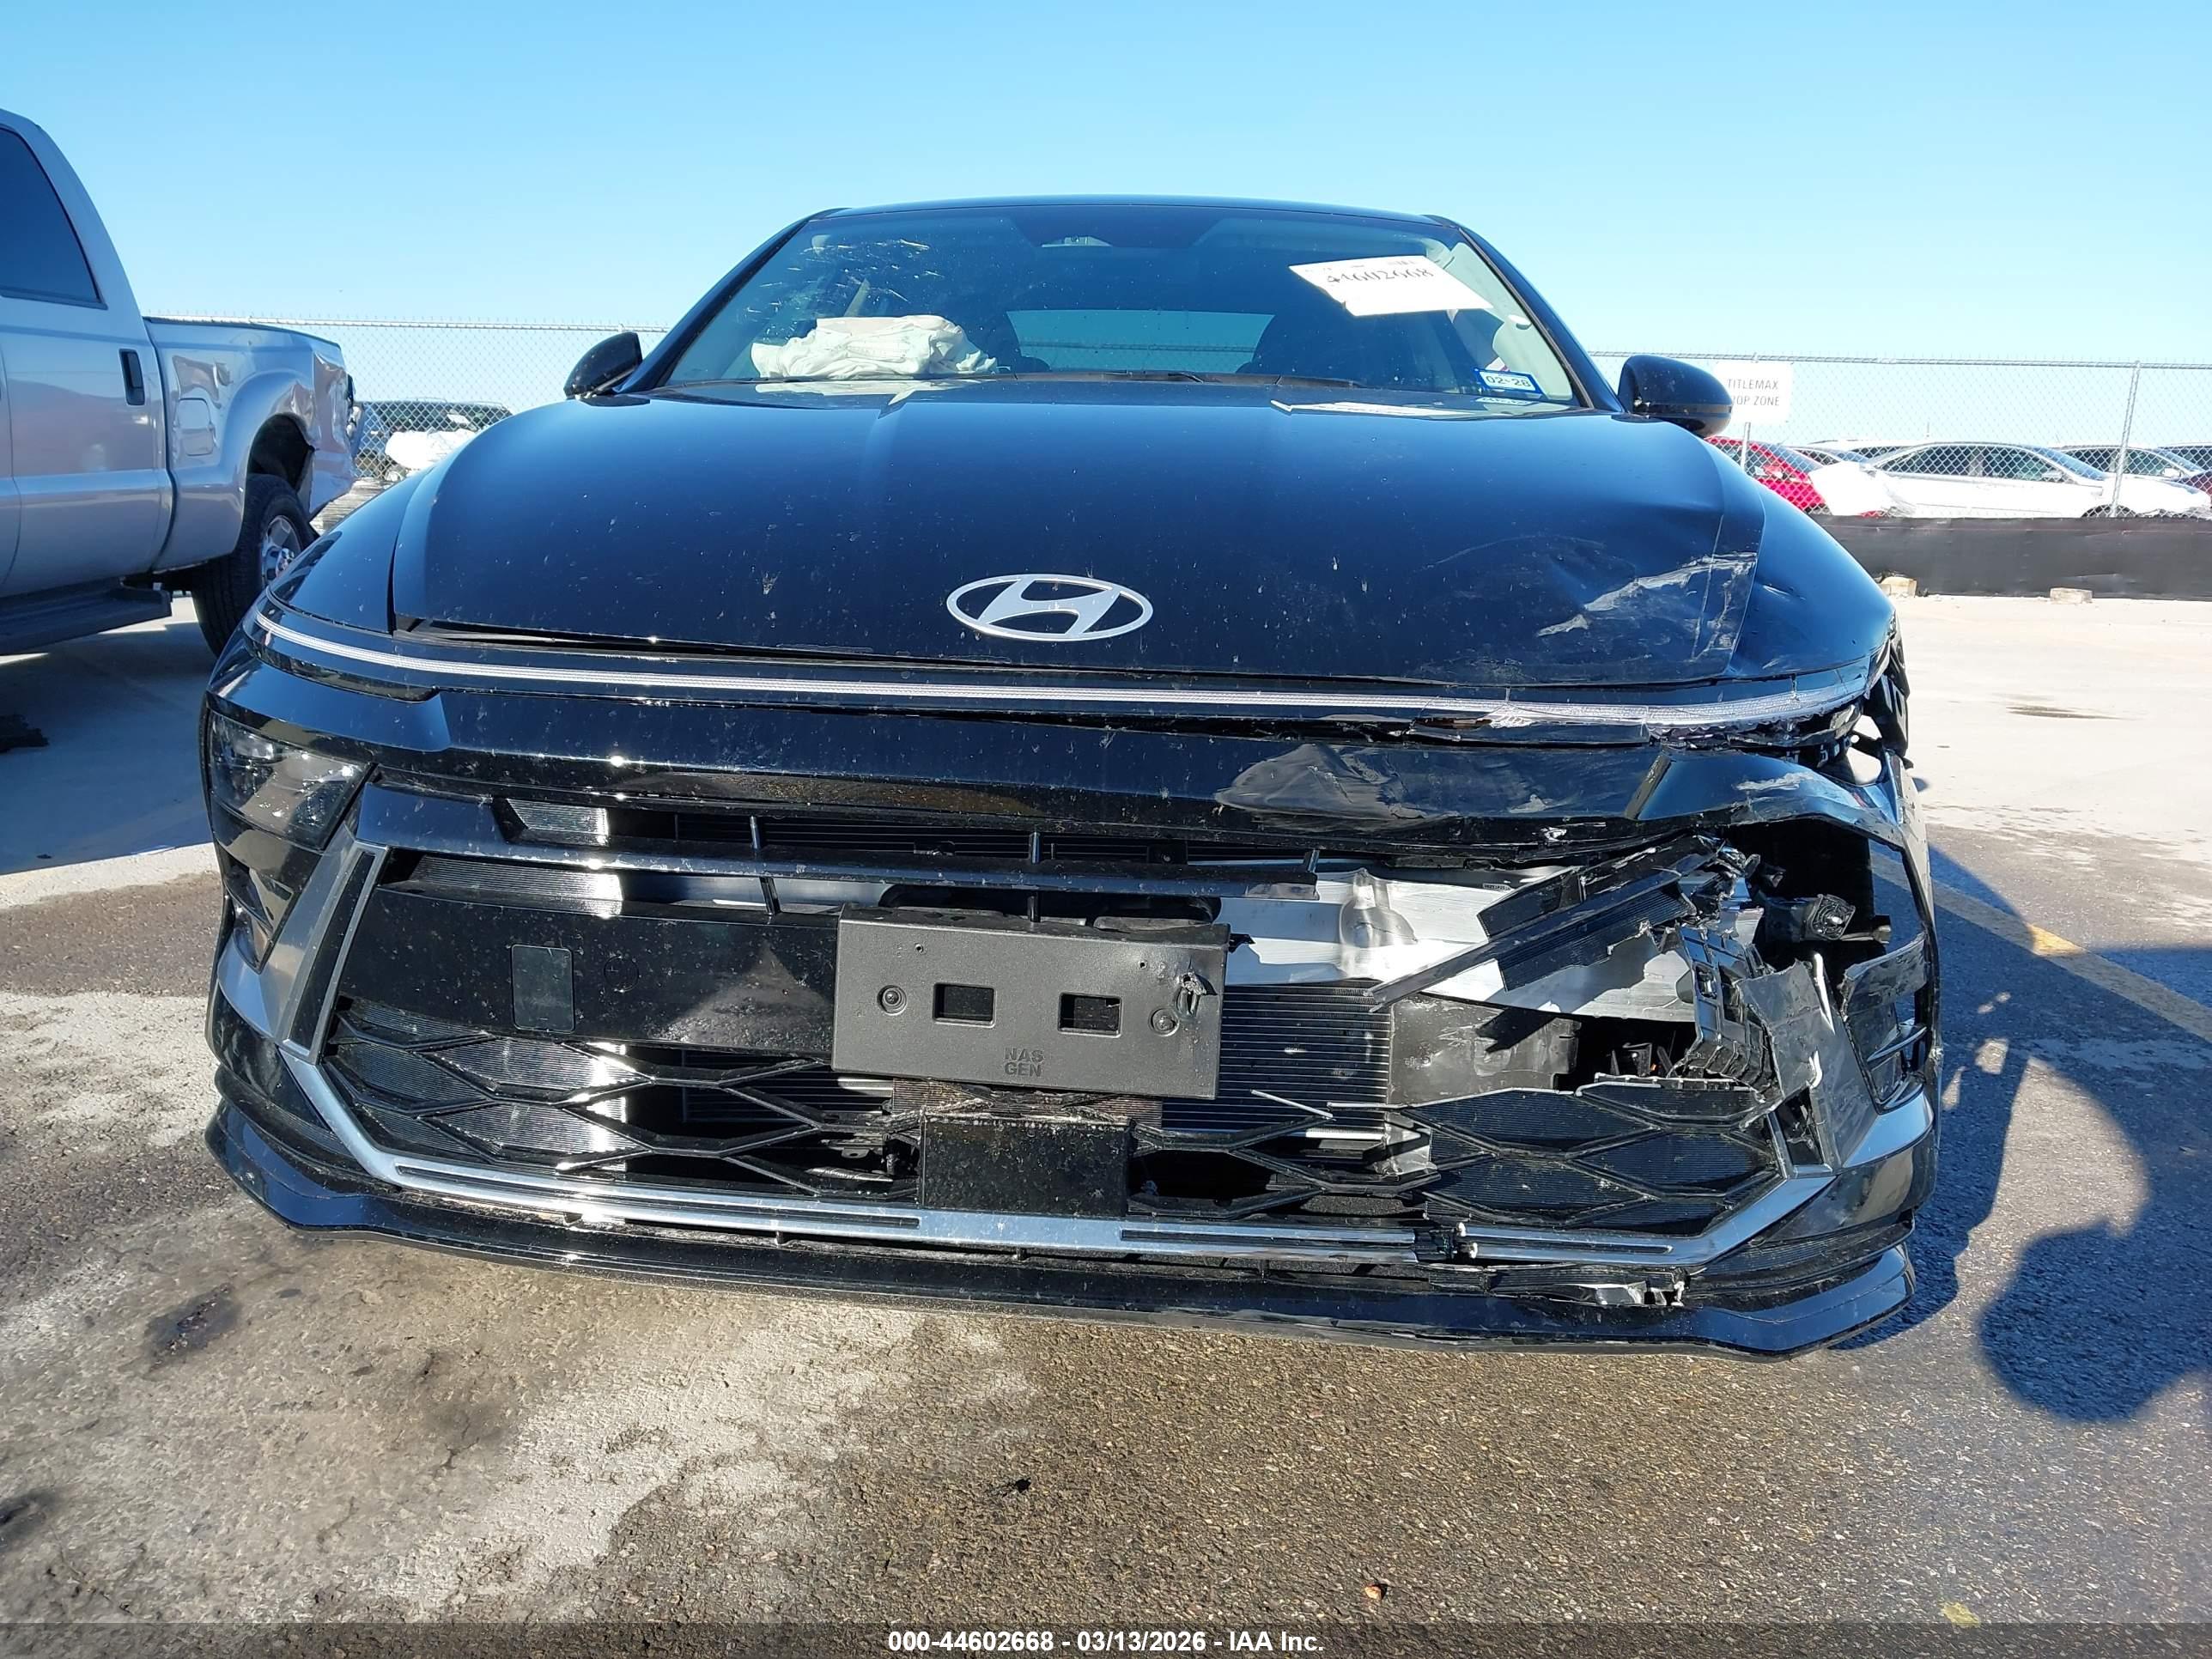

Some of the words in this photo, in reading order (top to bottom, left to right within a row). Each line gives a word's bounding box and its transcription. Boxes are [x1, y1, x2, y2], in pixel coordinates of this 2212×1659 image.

[1728, 379, 1778, 390] TITLEMAX
[1753, 396, 1780, 405] ZONE
[1004, 1047, 1045, 1062] NAS
[1004, 1061, 1042, 1077] GEN
